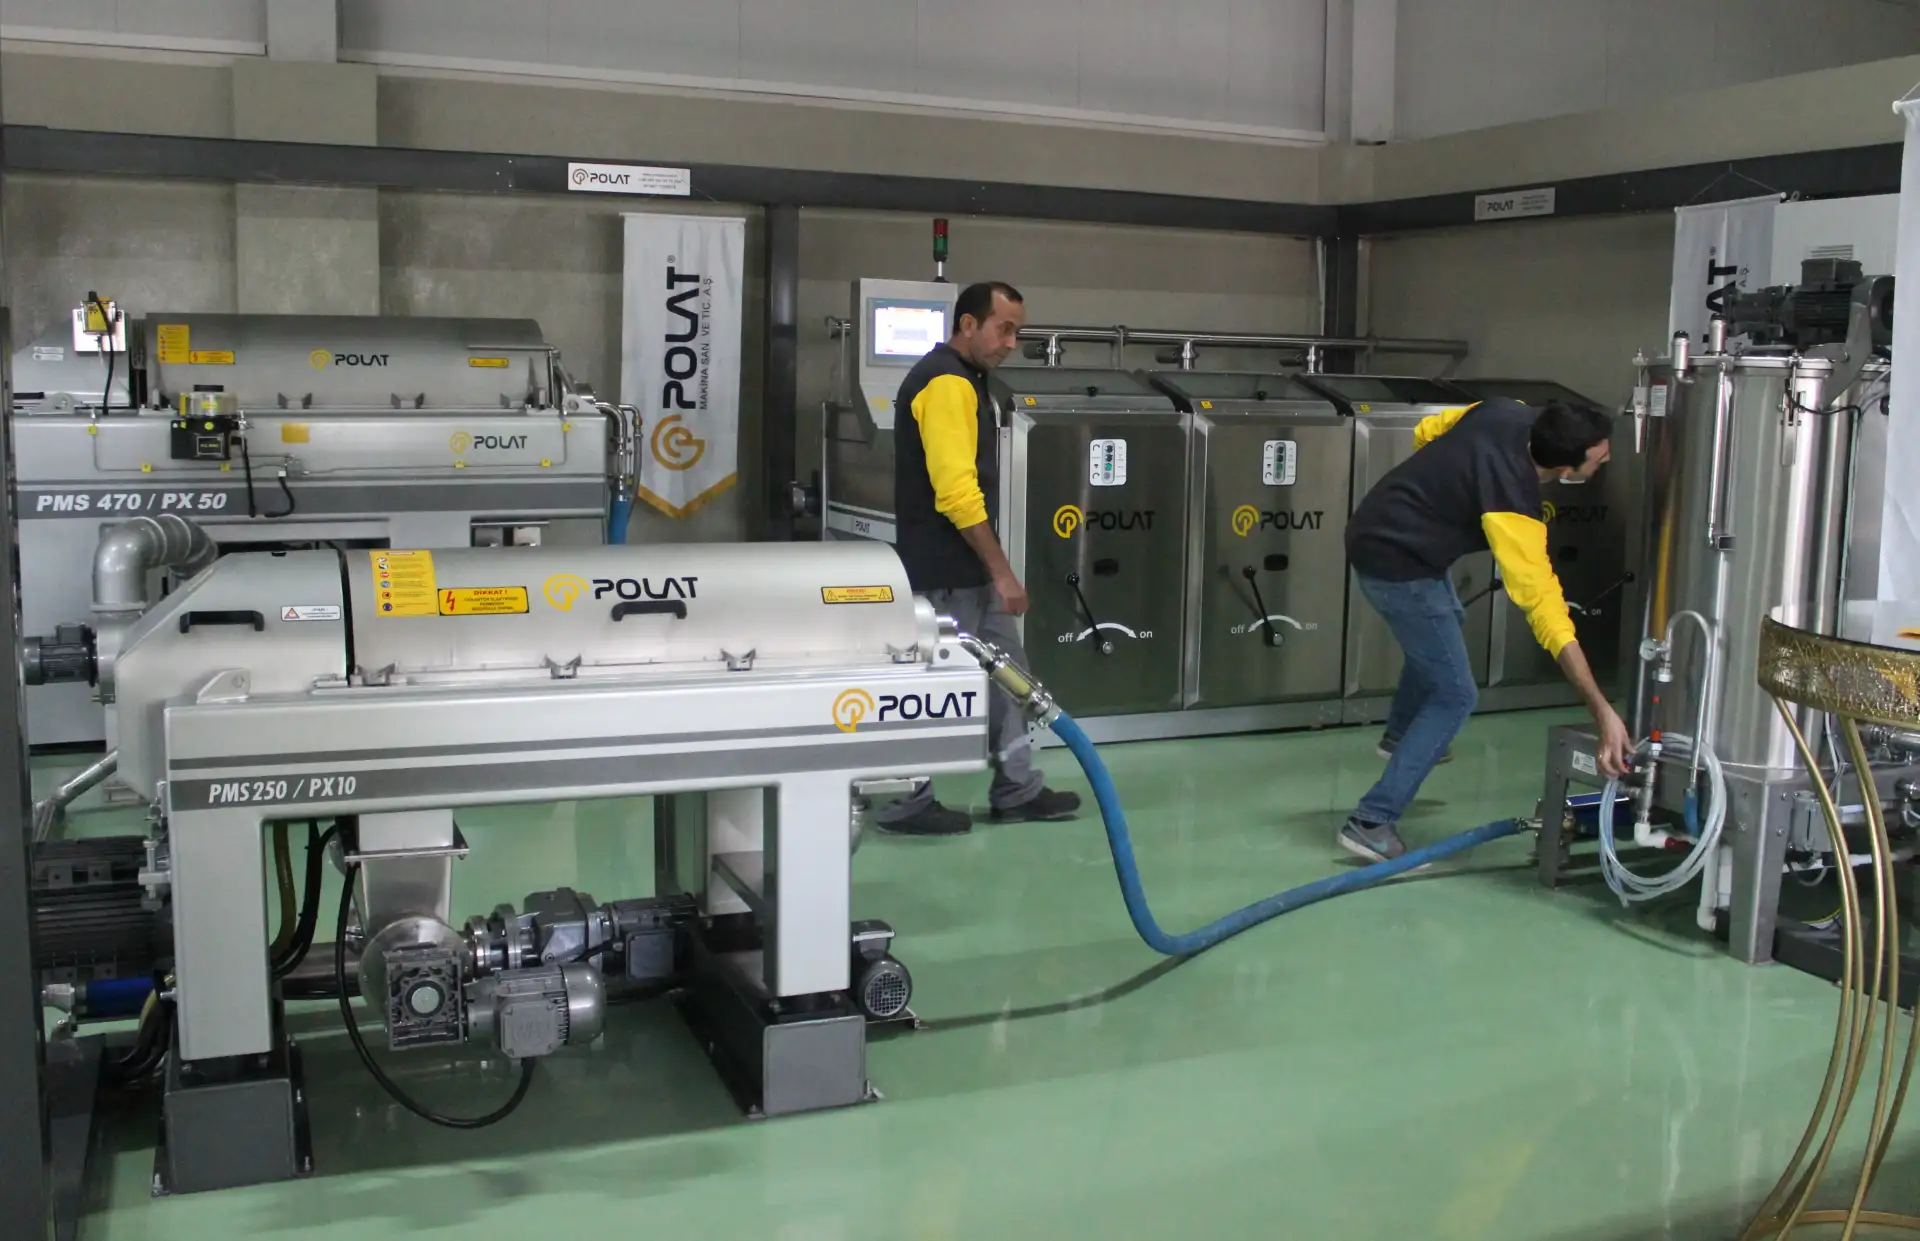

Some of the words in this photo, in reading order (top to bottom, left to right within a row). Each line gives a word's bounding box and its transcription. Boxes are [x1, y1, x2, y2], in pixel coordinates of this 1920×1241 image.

[590, 173, 630, 185] POLAT
[1487, 200, 1514, 212] POLAT
[701, 322, 710, 337] VE
[663, 266, 700, 410] POLAT
[334, 353, 390, 367] POLAT
[473, 435, 528, 449] POLAT
[36, 494, 91, 512] PMS
[96, 493, 143, 511] 470
[161, 493, 195, 510] PX
[197, 493, 227, 510] 50
[1086, 510, 1156, 531] POLAT
[1261, 510, 1324, 531] POLAT
[592, 576, 698, 600] POLAT
[1591, 608, 1602, 616] on
[1230, 624, 1245, 634] off
[1305, 621, 1318, 630] on
[1058, 632, 1074, 643] off
[1140, 630, 1153, 639] on
[879, 691, 977, 722] POLAT
